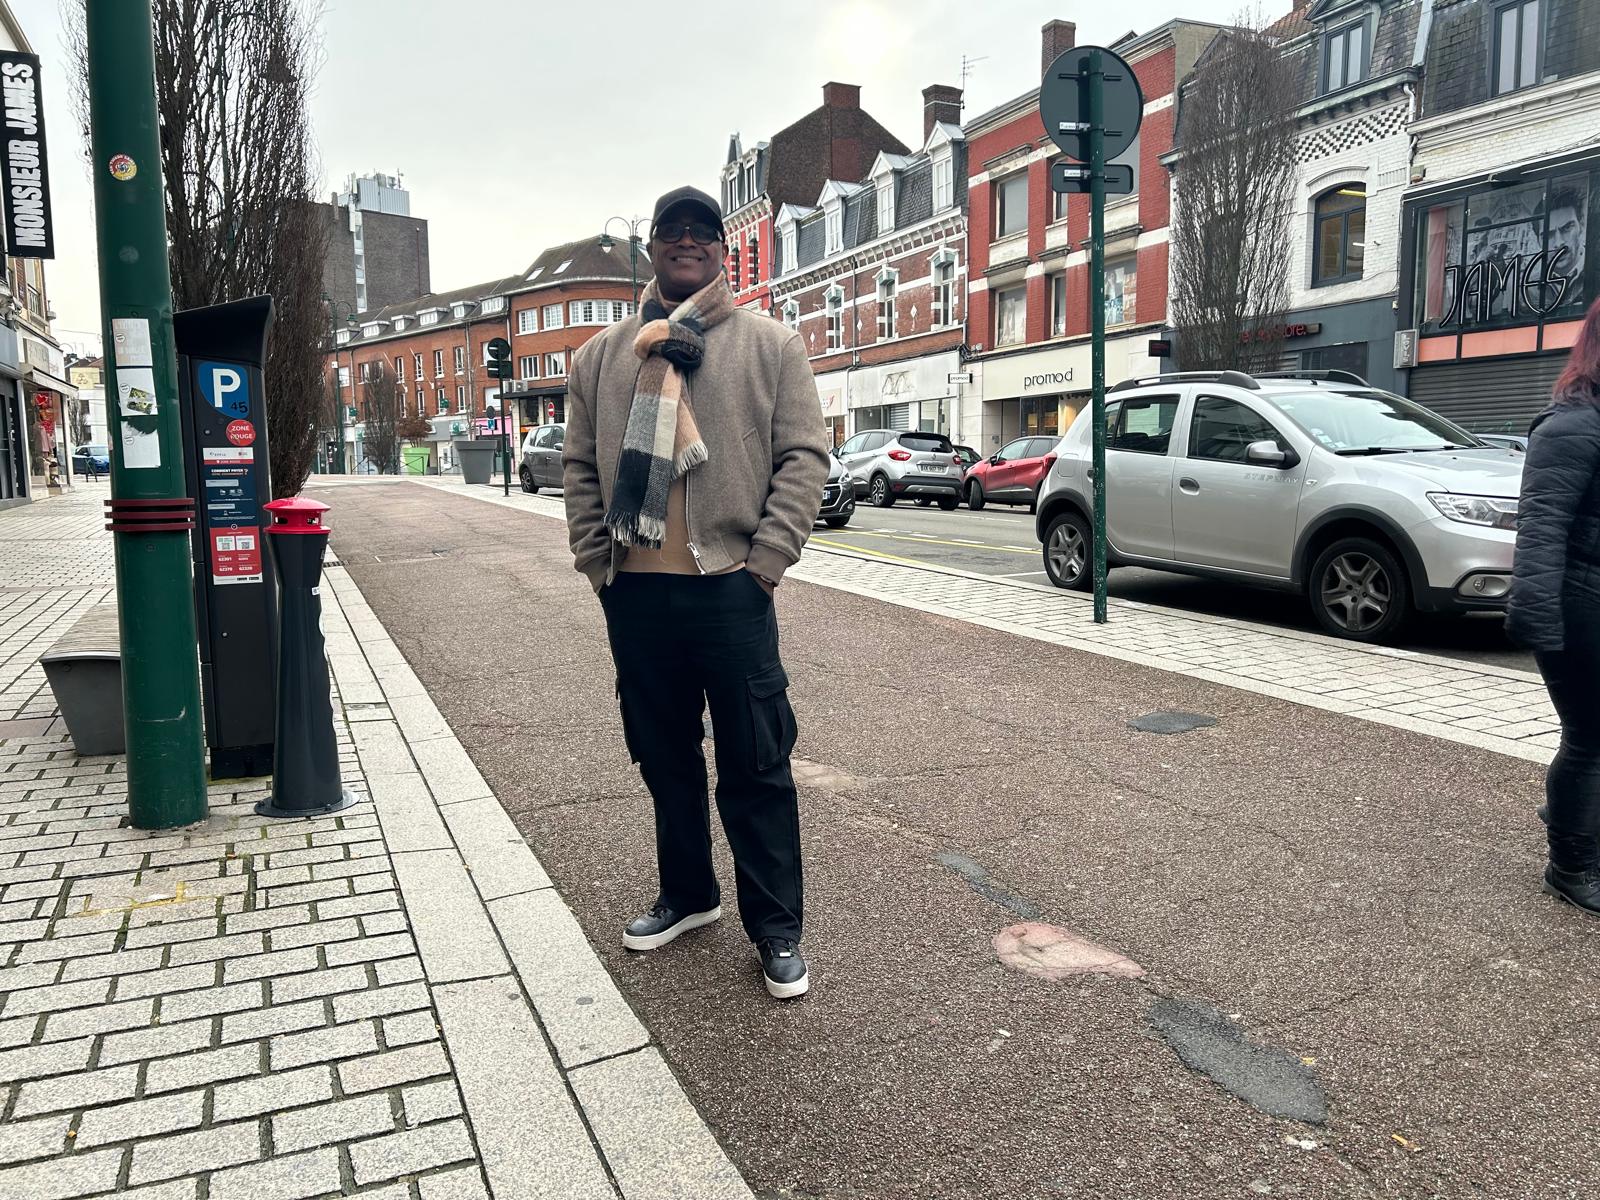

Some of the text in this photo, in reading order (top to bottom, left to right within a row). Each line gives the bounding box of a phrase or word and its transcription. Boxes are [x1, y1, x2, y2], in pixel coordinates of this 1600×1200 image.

[1, 62, 46, 248] MONSIEUR JAMES
[1439, 246, 1569, 329] JAMES
[212, 368, 241, 408] P
[1024, 367, 1073, 390] promod
[231, 401, 248, 413] 45
